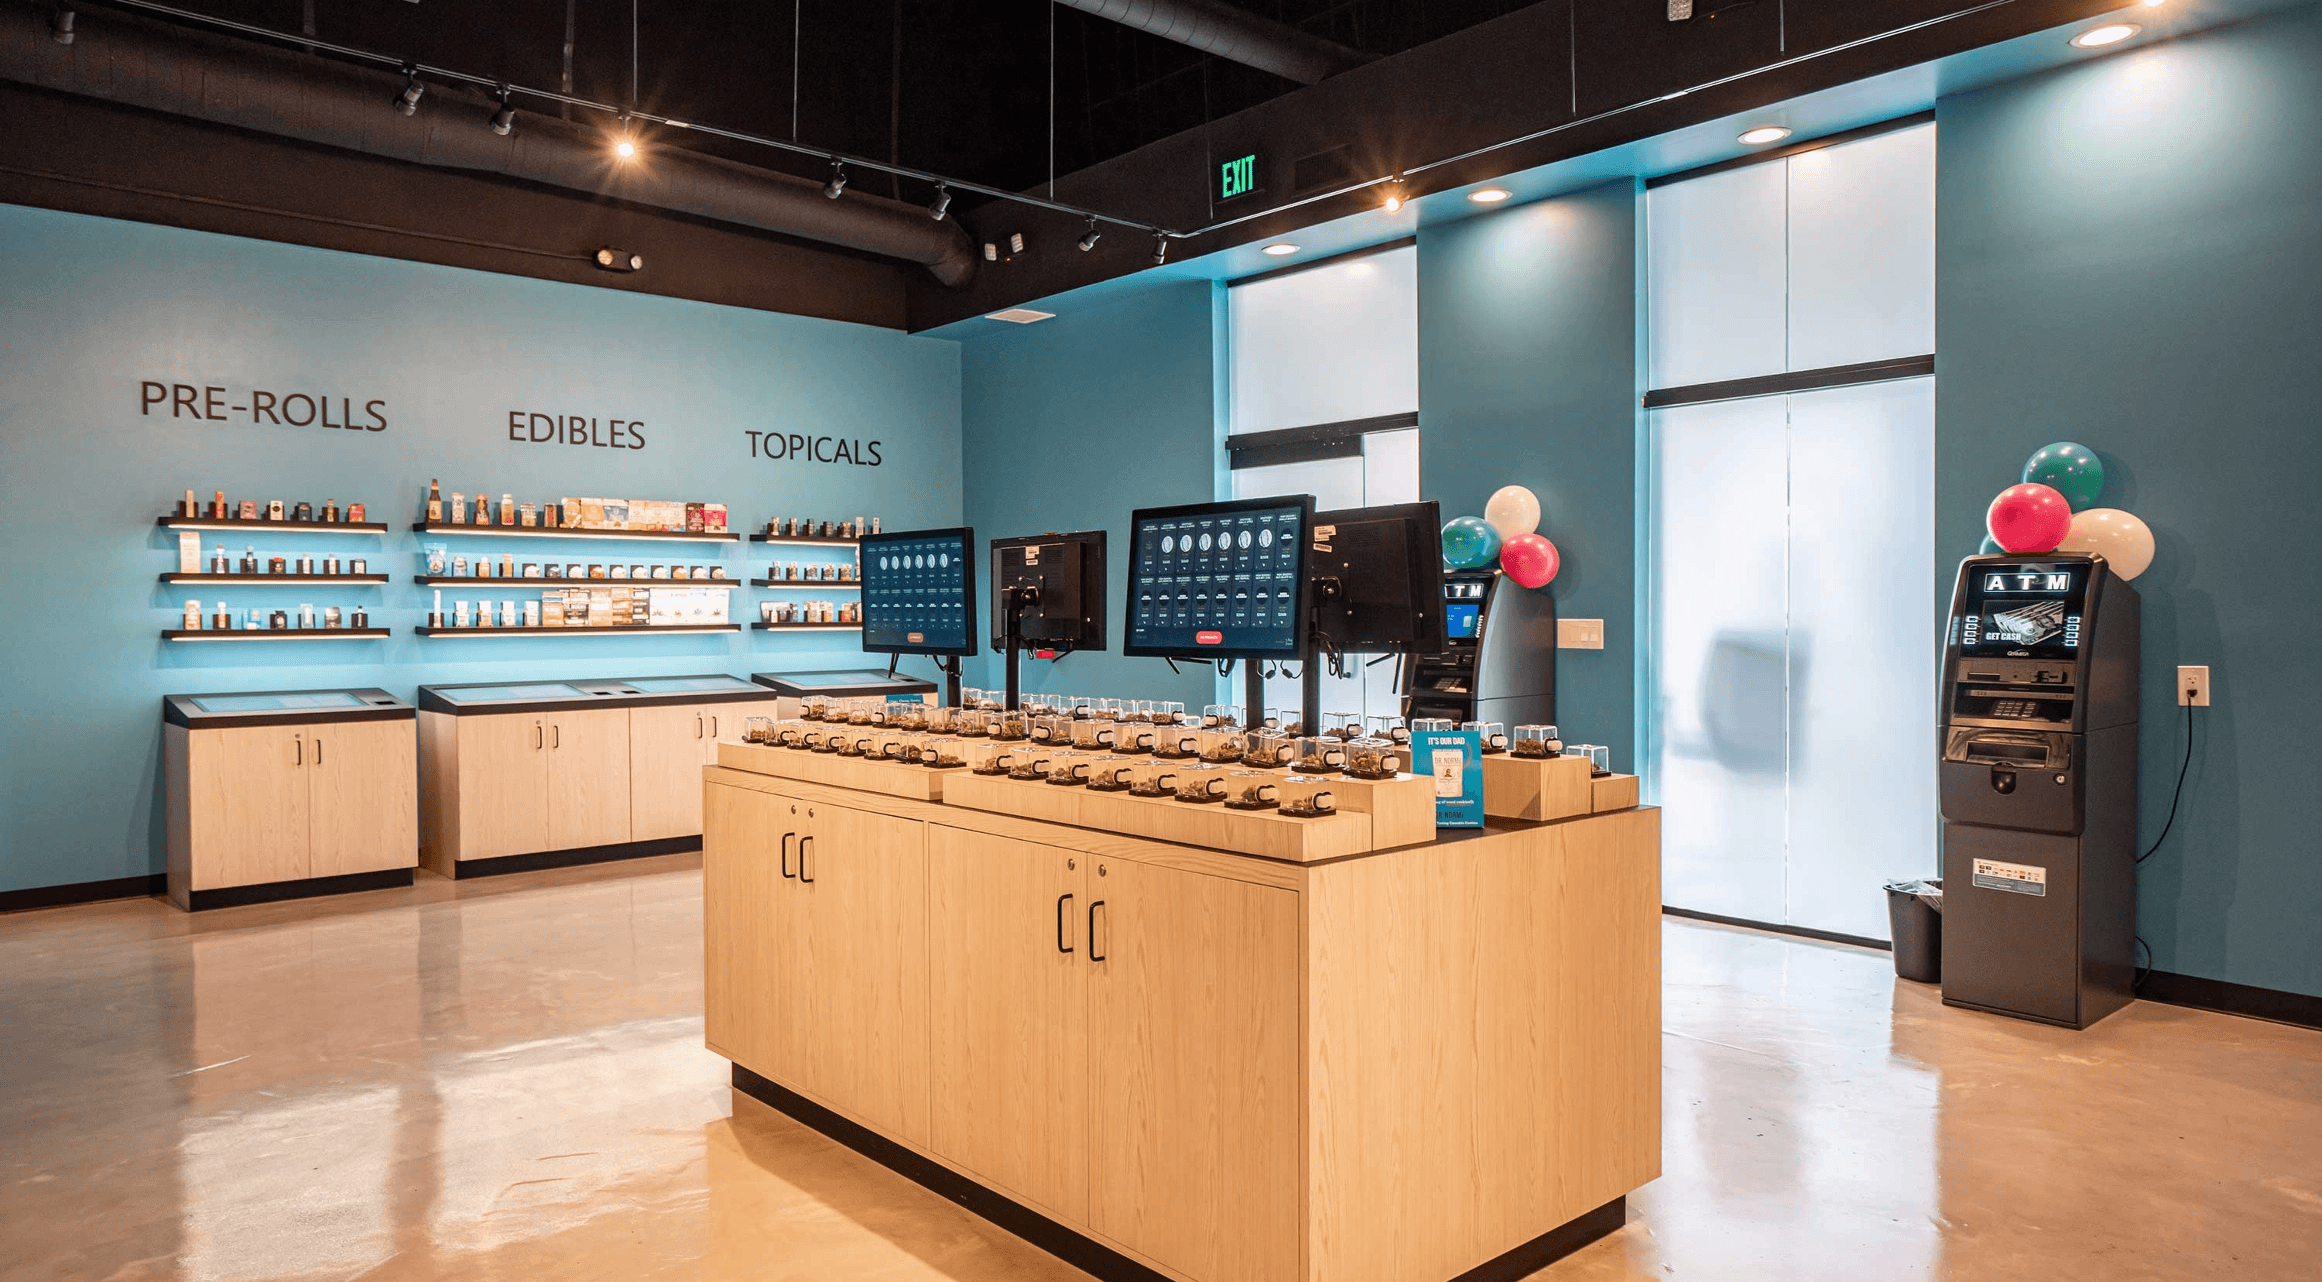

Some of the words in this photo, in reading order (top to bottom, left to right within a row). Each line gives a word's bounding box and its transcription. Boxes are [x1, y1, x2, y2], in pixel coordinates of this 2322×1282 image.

[1222, 154, 1255, 198] EXIT
[140, 381, 387, 432] PRE-ROLLS
[508, 411, 646, 450] EDIBLES
[745, 430, 882, 466] TOPICALS
[1444, 585, 1482, 597] TM
[1987, 575, 2067, 590] ATM
[1986, 632, 2000, 641] GET
[2001, 633, 2021, 641] CASH
